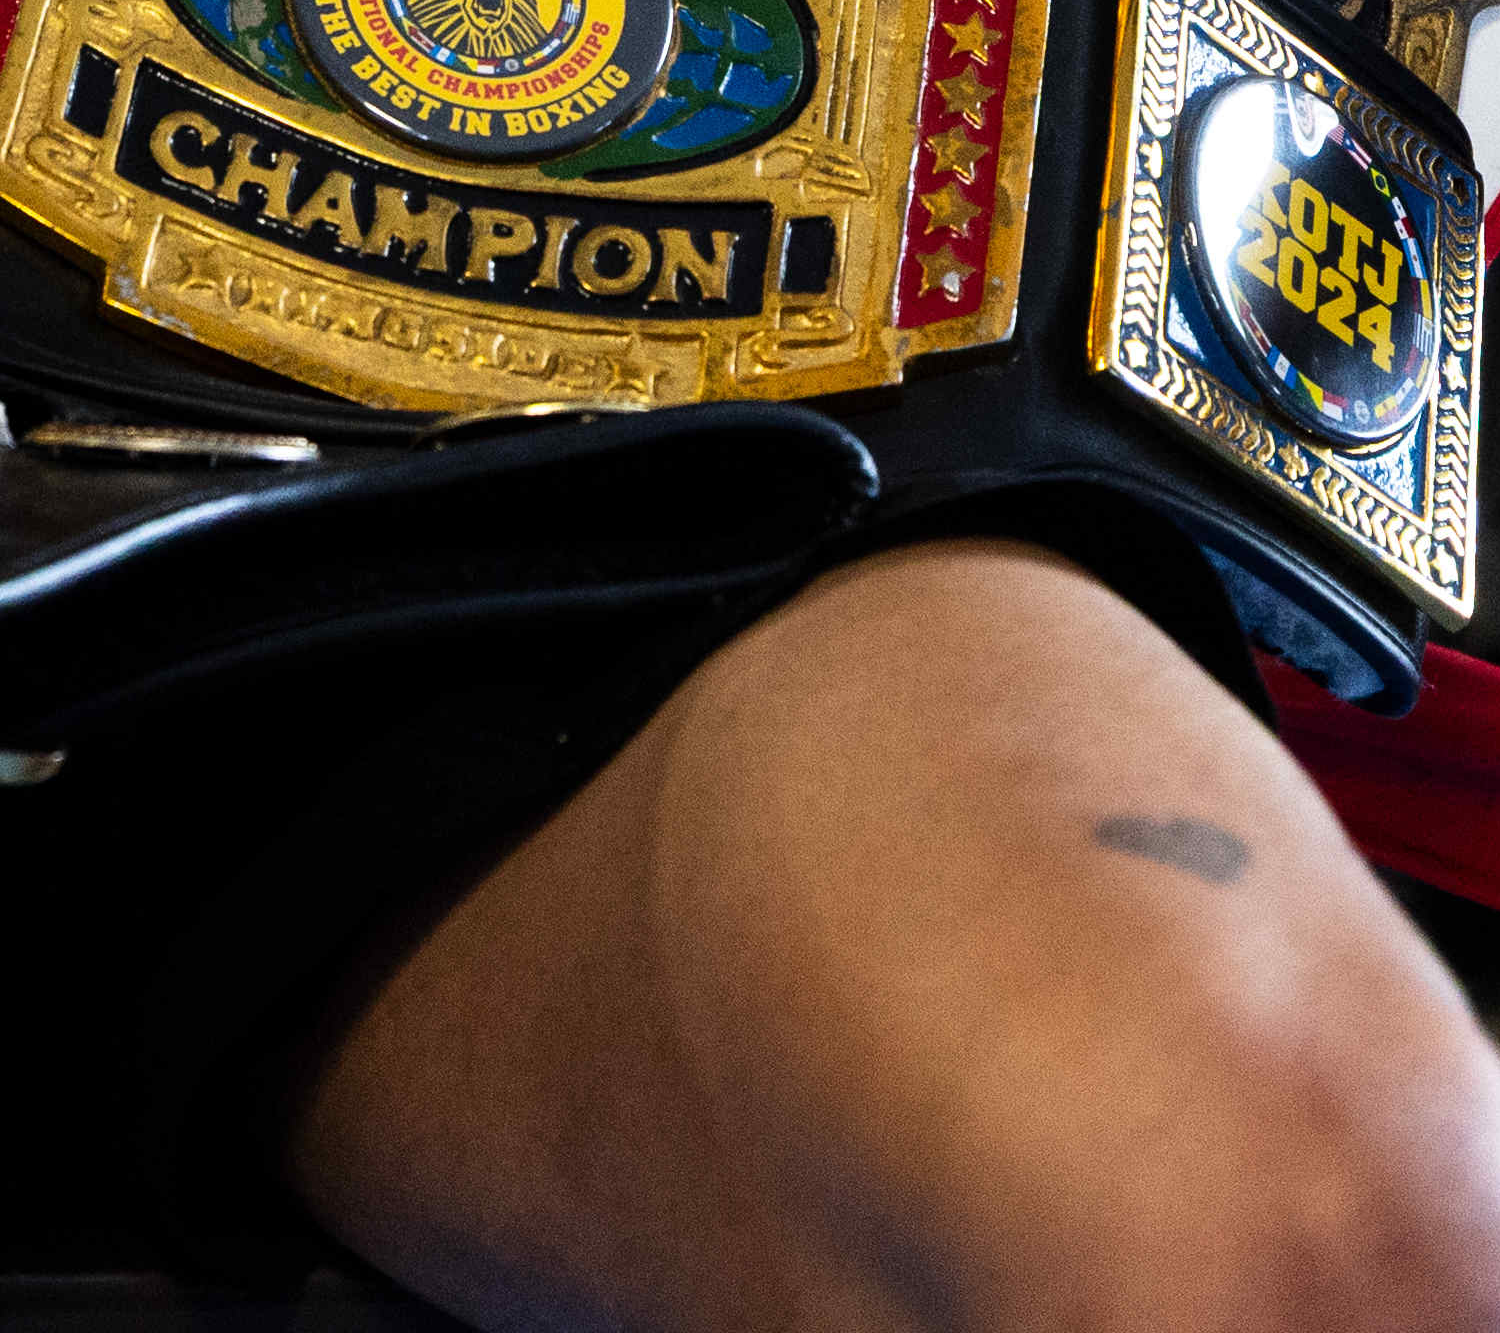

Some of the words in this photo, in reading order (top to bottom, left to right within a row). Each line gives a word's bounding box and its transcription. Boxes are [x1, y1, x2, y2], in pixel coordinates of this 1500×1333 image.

[350, 53, 443, 122] BEST
[449, 107, 493, 138] IN
[505, 63, 632, 139] BOXING
[426, 19, 612, 101] CHAMPIONSHIPS
[147, 110, 740, 305] CHAMPION
[1236, 206, 1396, 375] 2024
